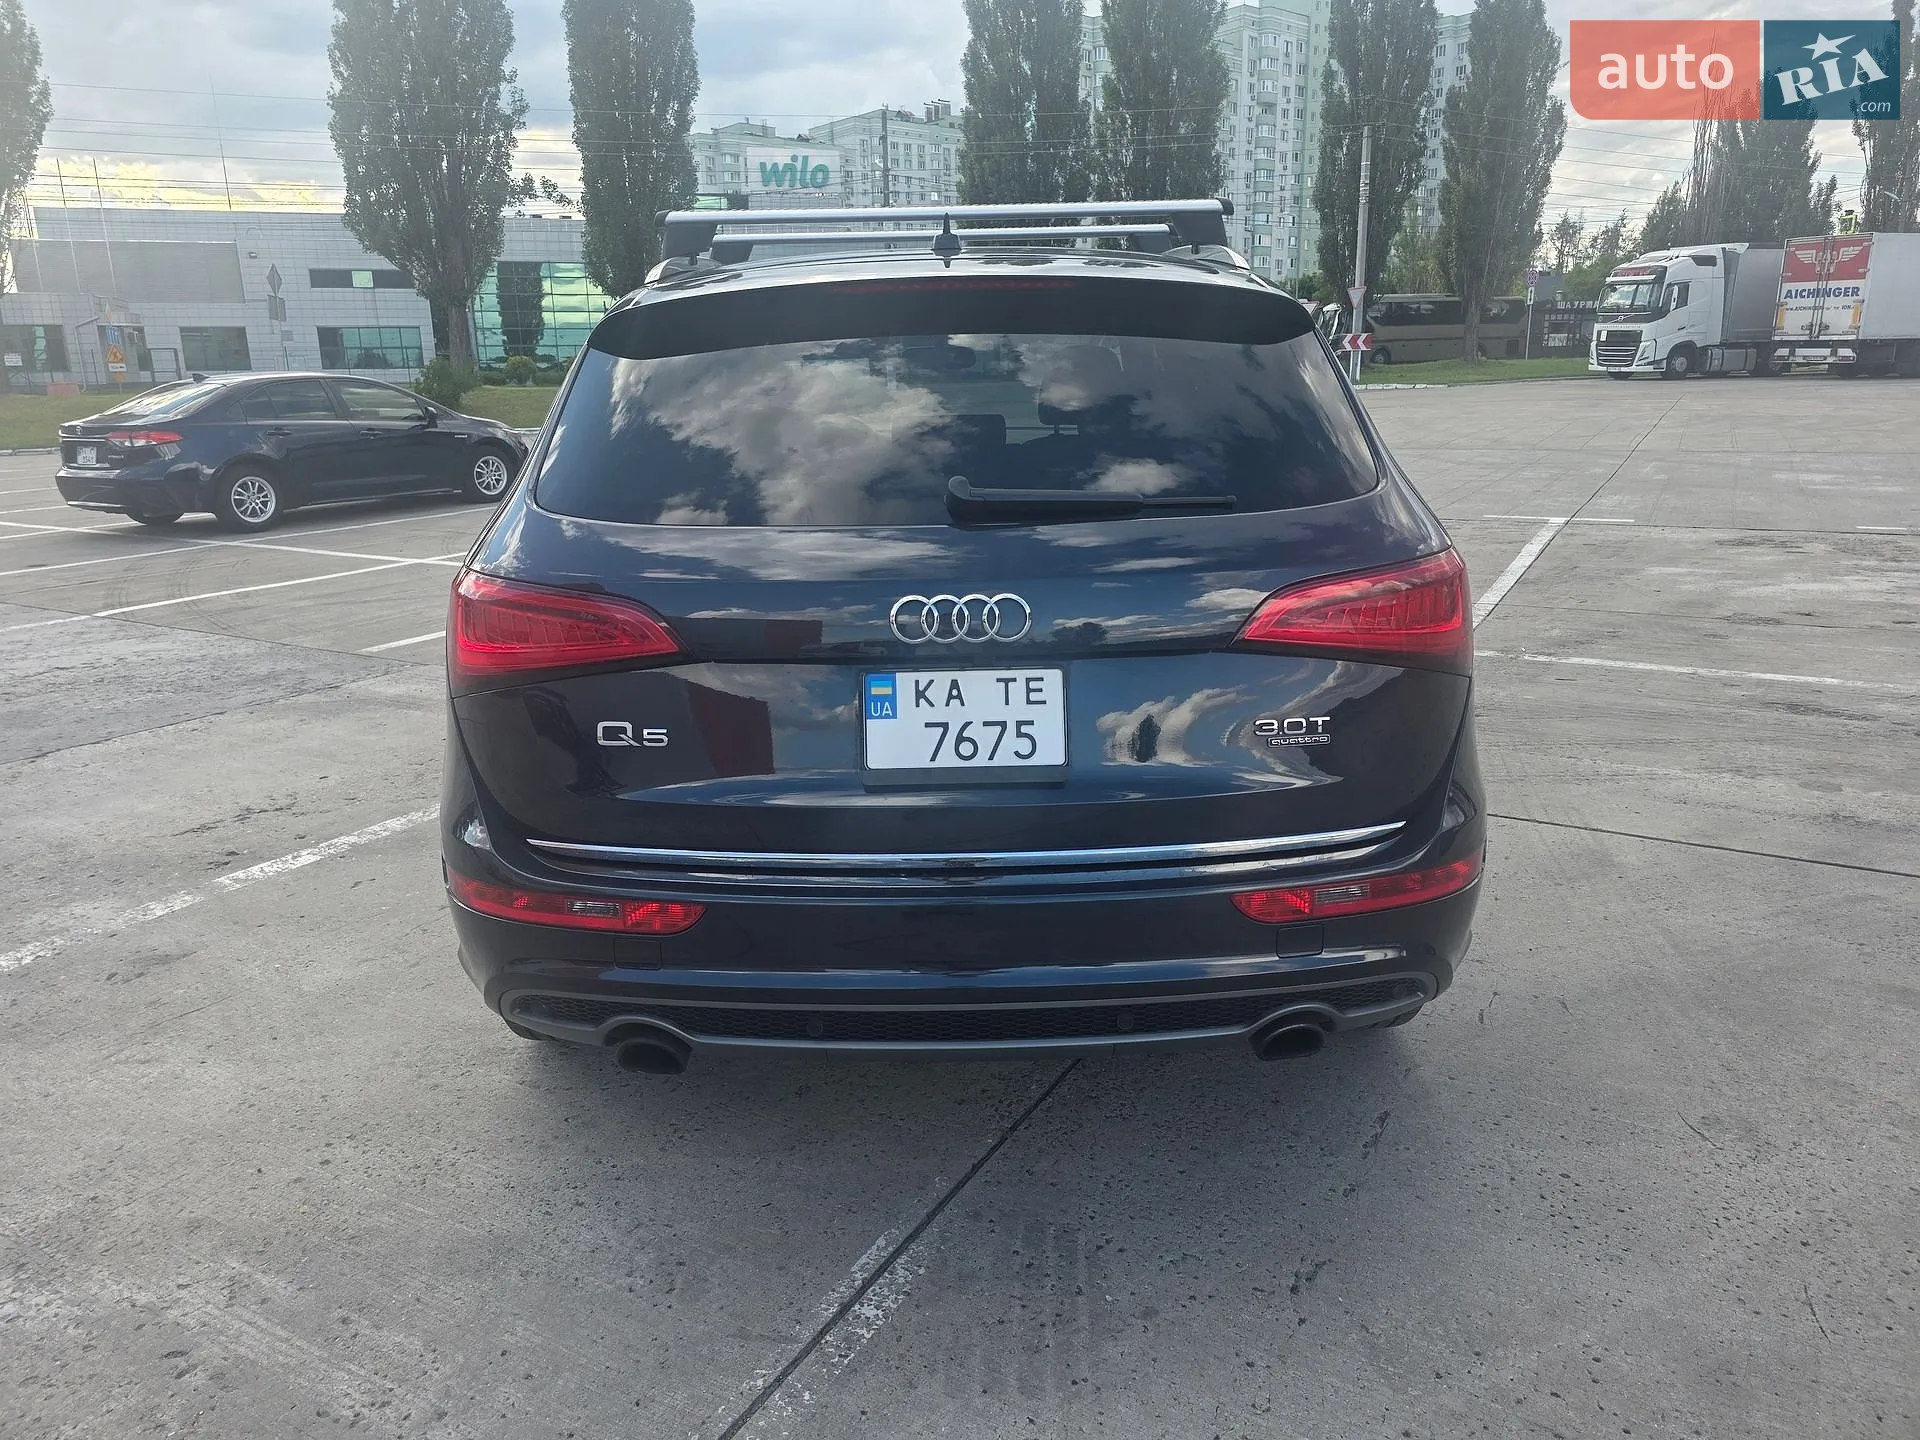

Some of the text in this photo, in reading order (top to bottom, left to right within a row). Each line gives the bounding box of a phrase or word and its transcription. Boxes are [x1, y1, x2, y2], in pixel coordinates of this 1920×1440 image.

[759, 155, 830, 188] wilo
[1784, 286, 1861, 300] AICHINGER
[914, 677, 1047, 708] KA TE
[871, 701, 893, 717] UA
[597, 721, 669, 747] Q5
[1255, 716, 1331, 736] 3.0T
[924, 720, 1037, 762] 7675
[1271, 736, 1328, 746] quattro
